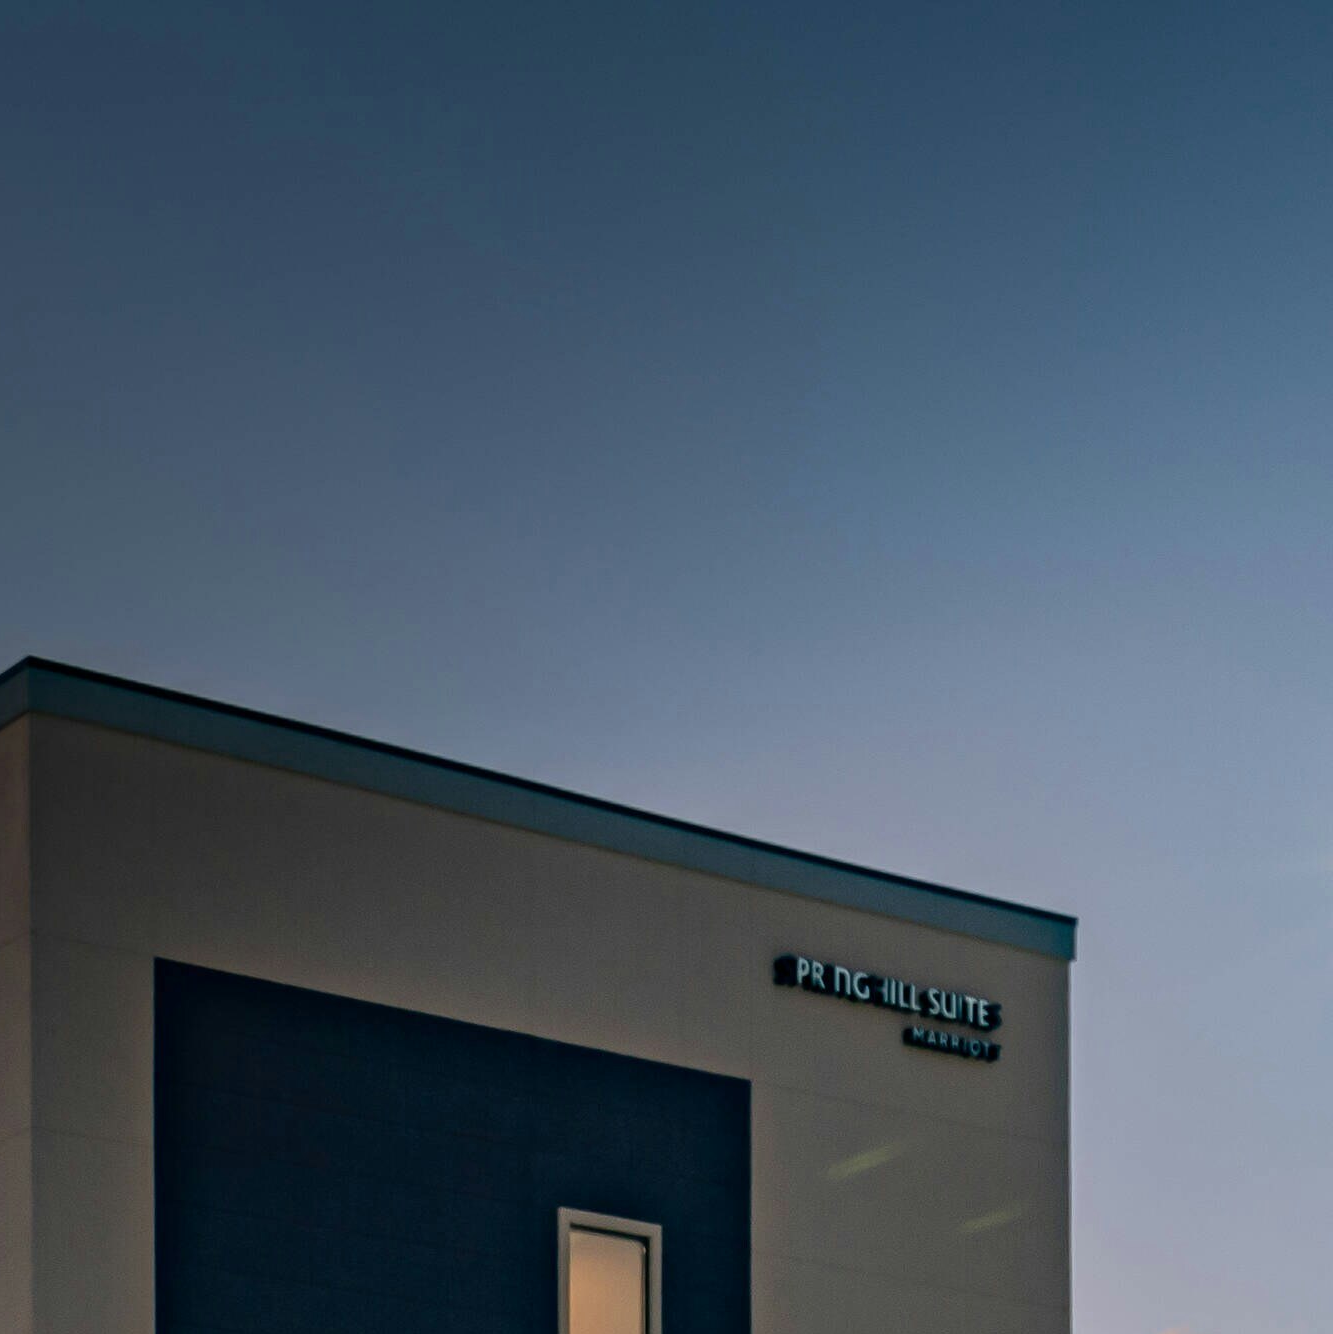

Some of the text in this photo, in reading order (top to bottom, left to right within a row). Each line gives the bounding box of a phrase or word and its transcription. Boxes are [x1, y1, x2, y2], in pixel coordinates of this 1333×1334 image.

[775, 954, 1001, 1029] PRNGHILL SUITE
[910, 1026, 1001, 1061] MARRIOT
